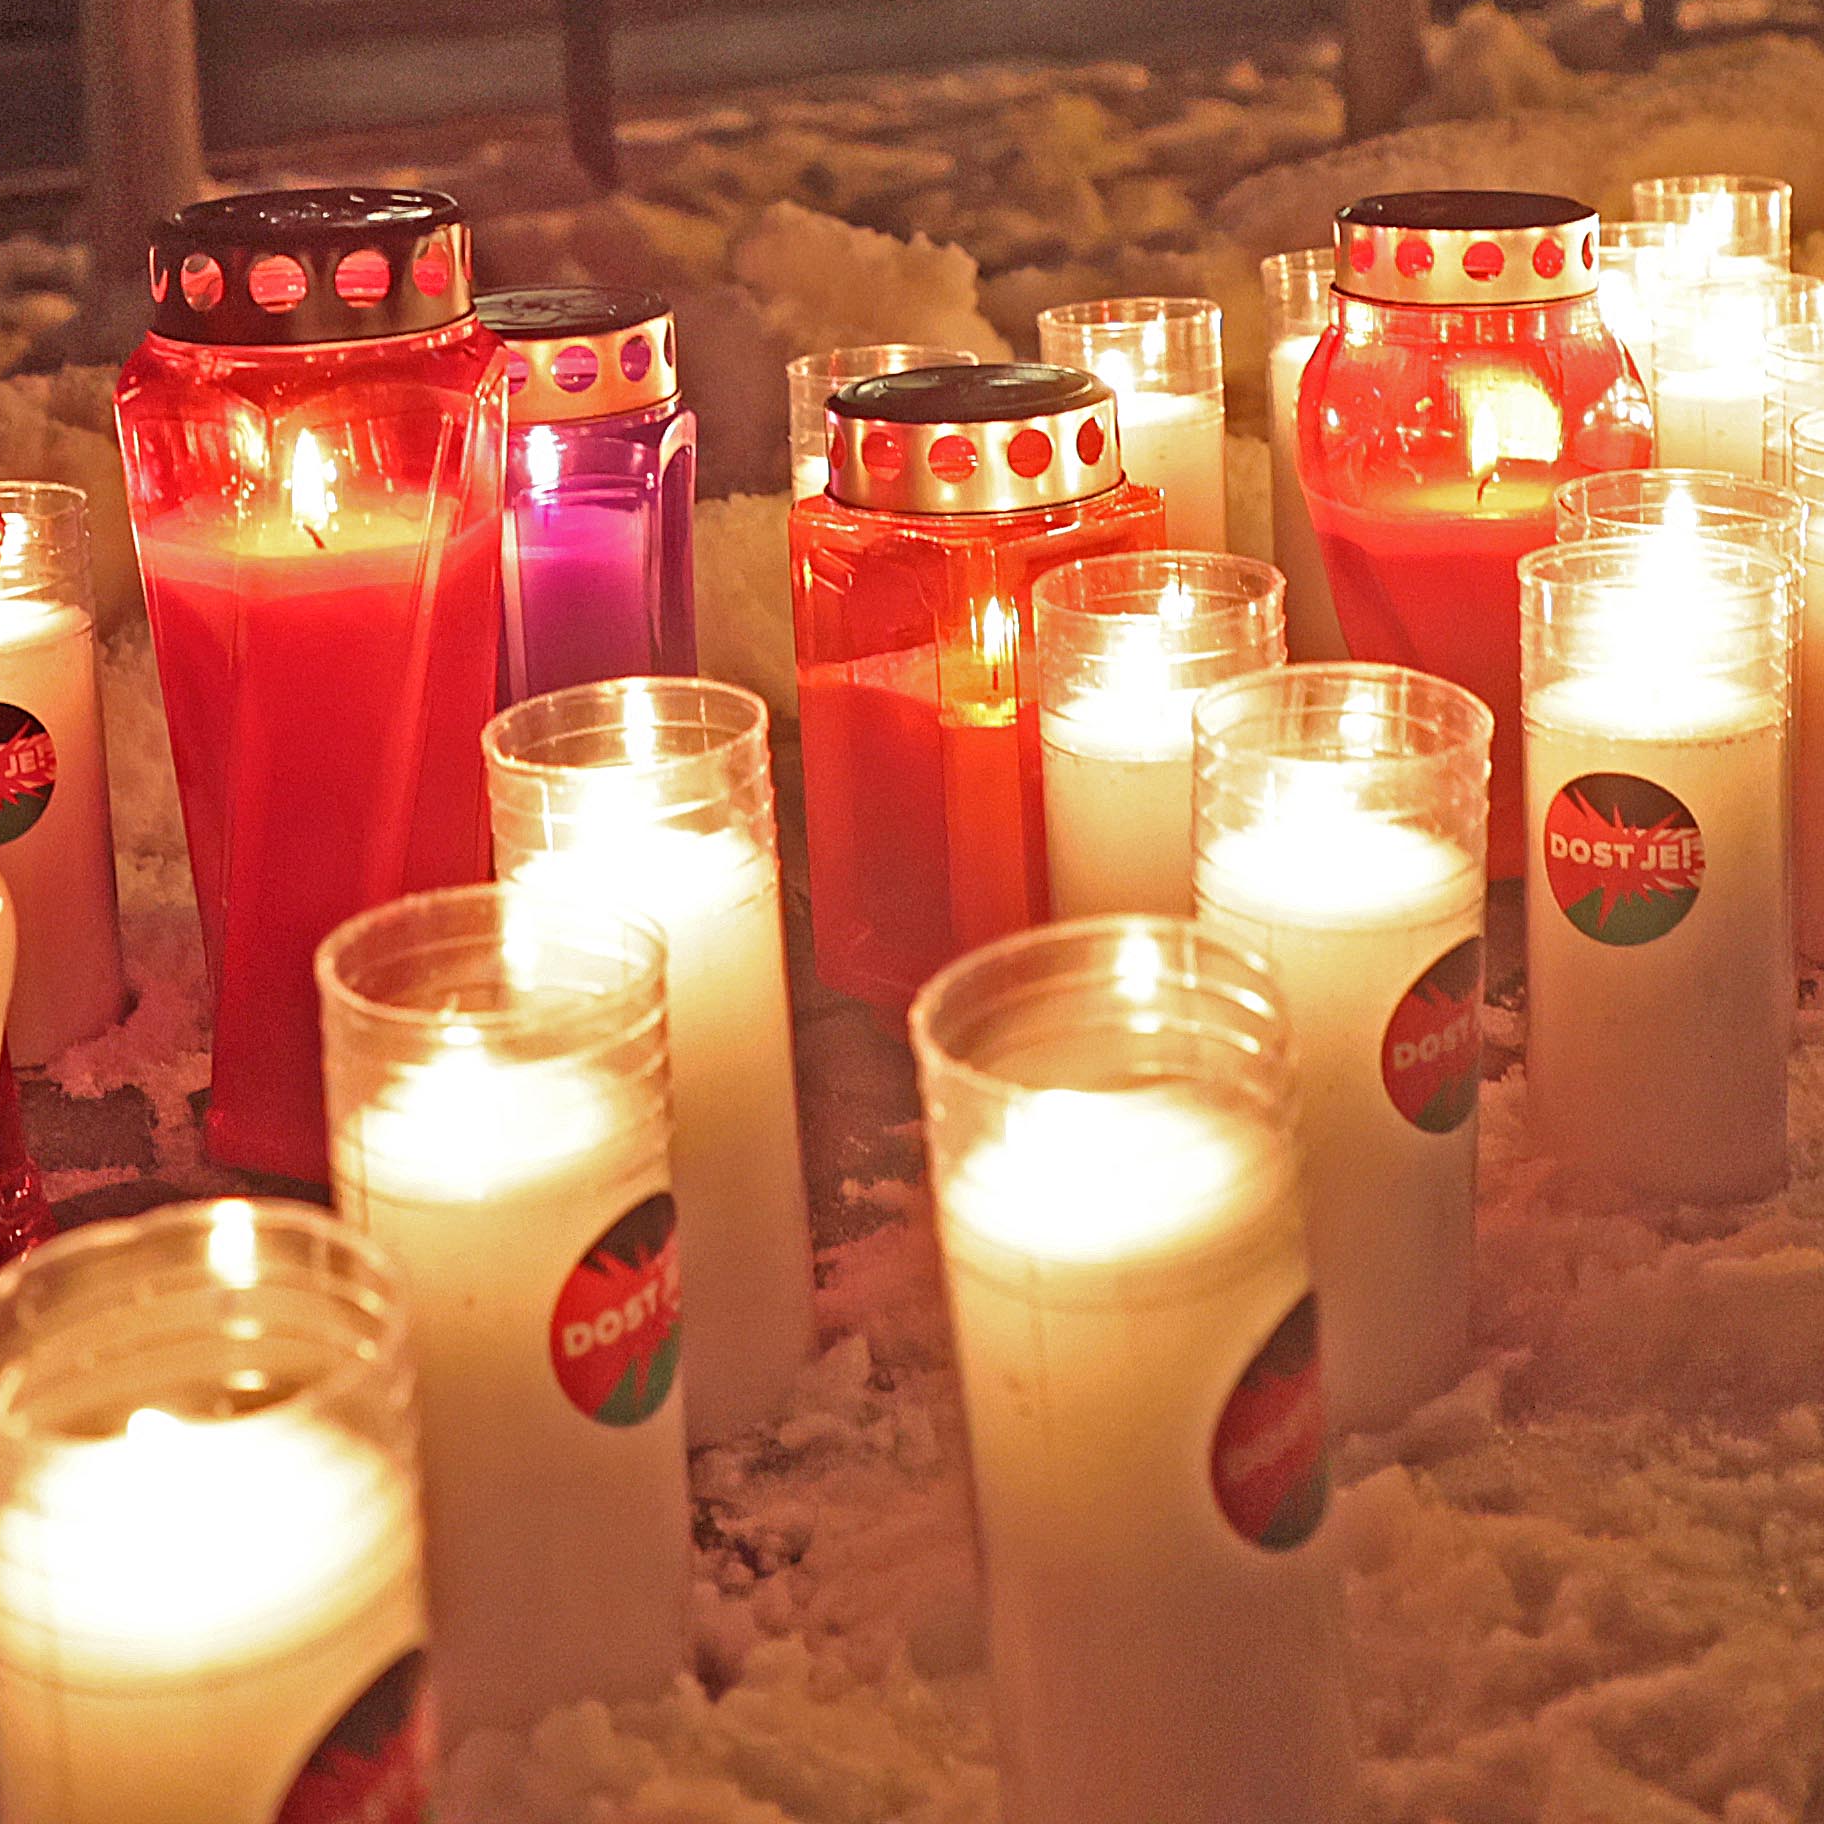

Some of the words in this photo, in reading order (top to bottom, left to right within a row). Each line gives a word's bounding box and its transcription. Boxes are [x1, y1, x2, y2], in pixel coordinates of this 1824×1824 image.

[4, 745, 46, 778] JE!
[1550, 832, 1635, 870] DOST
[1639, 838, 1692, 871] JE!
[563, 1279, 660, 1359] DOST
